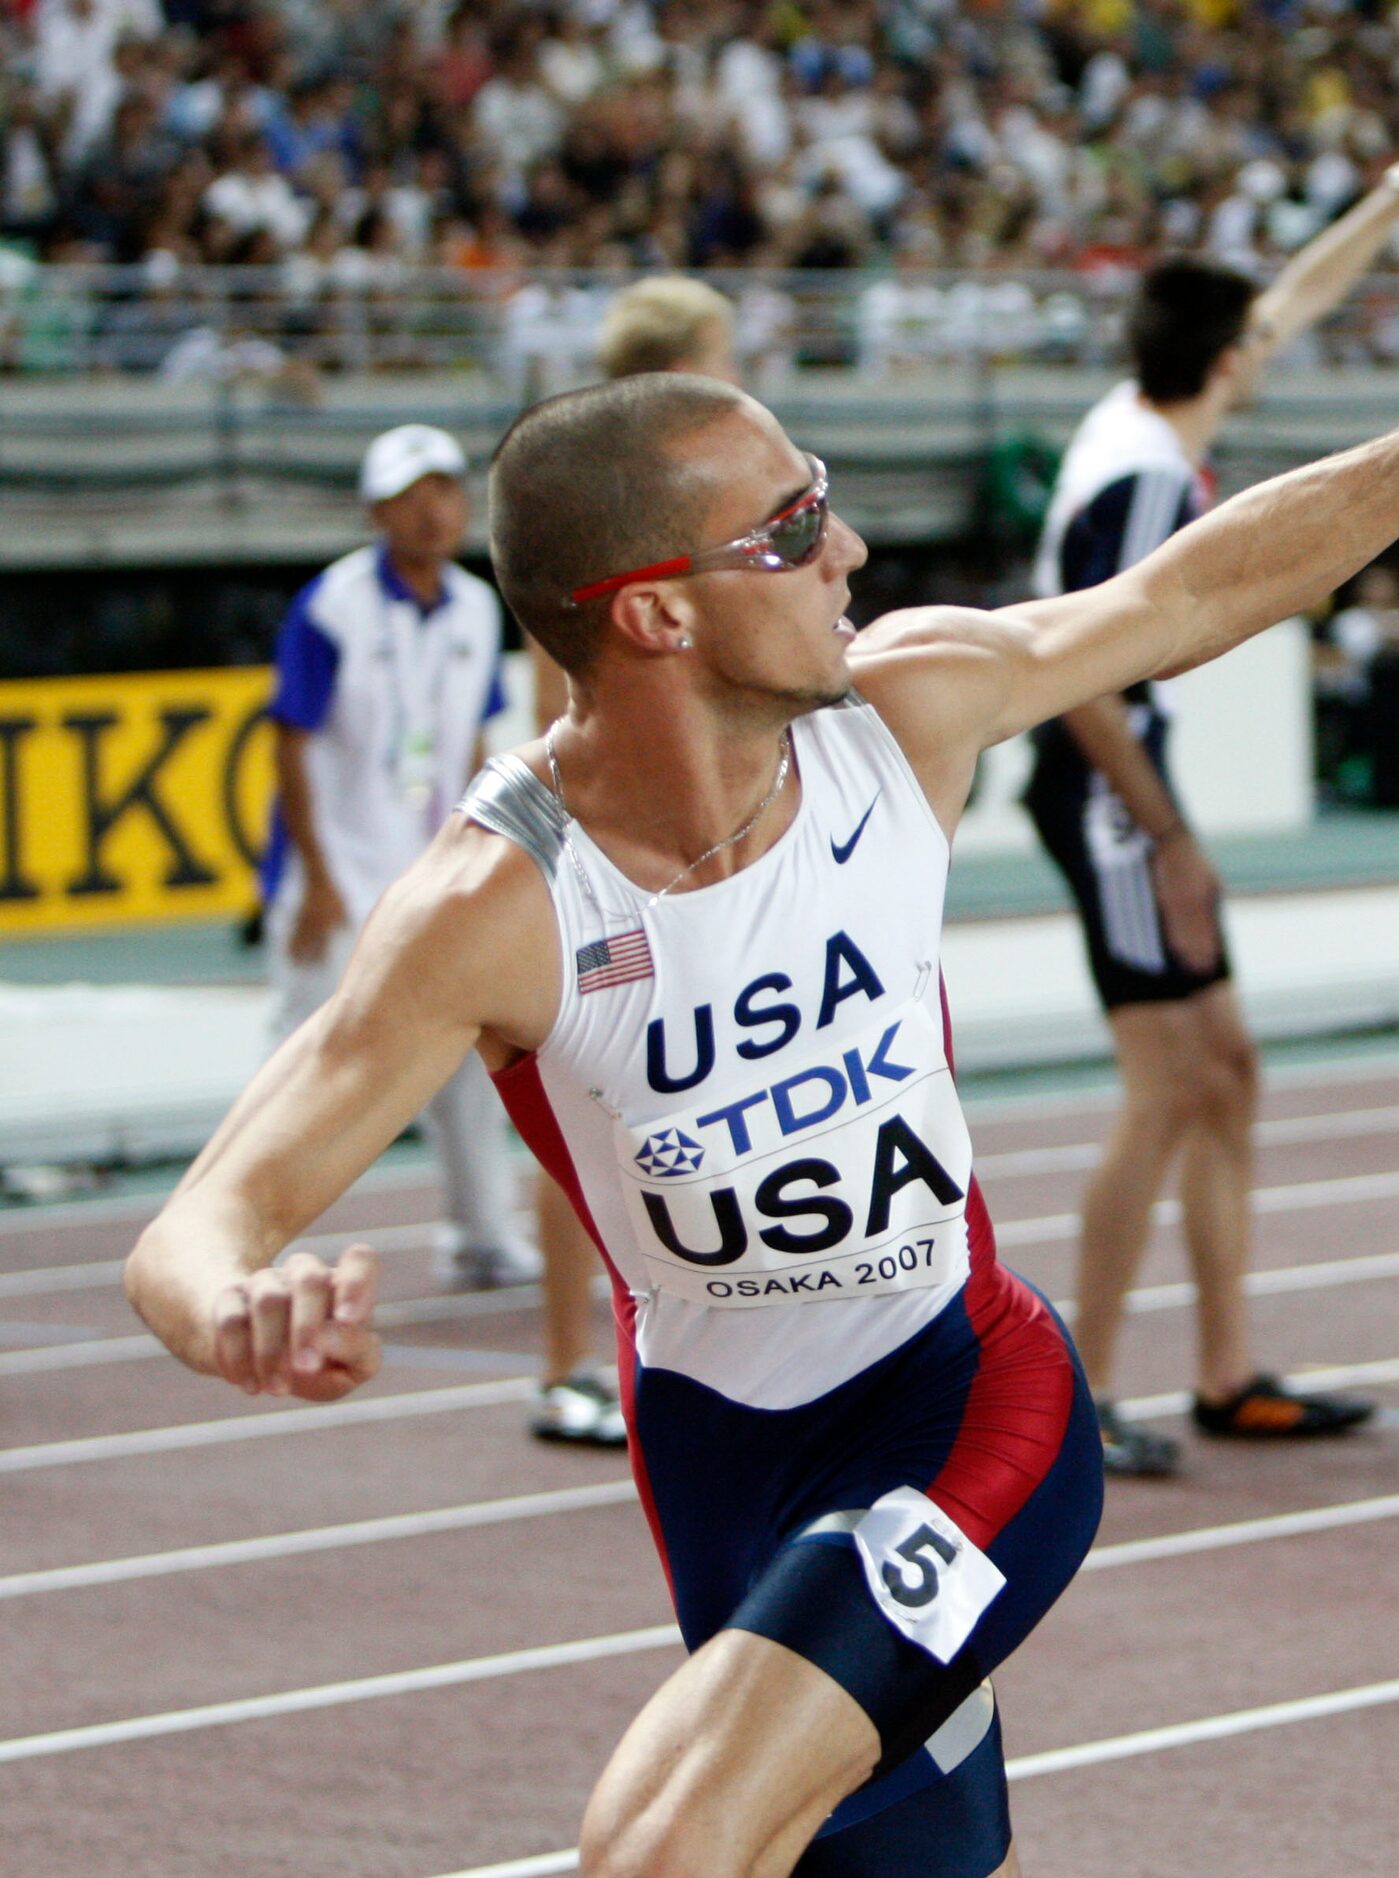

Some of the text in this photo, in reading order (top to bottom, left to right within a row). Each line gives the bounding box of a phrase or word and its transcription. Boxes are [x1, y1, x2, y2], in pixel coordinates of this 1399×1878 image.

[646, 929, 886, 1094] USA
[695, 1019, 917, 1157] TDK
[640, 1113, 965, 1267] USA
[705, 1238, 936, 1299] OSAKA 2007
[881, 1522, 957, 1608] 5
